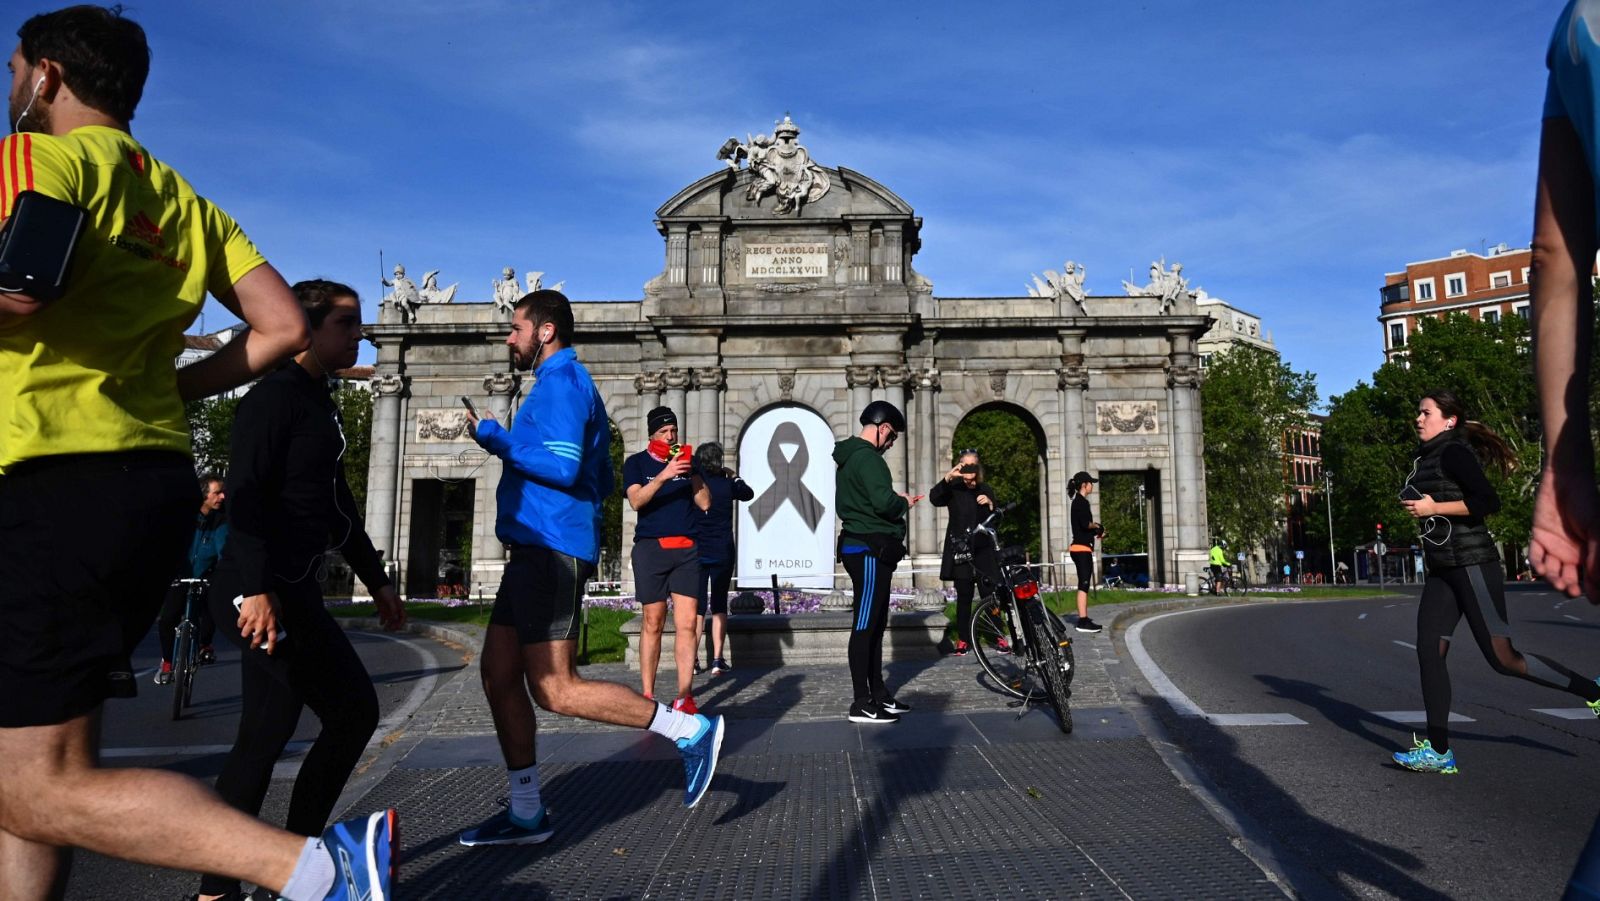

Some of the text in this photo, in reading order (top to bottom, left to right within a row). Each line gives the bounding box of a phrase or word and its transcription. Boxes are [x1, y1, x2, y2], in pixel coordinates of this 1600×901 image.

[746, 246, 829, 255] REGE CAROLO III
[772, 257, 803, 265] ANNO
[751, 266, 823, 275] MDCCLXXVIII
[769, 559, 813, 569] MADRID
